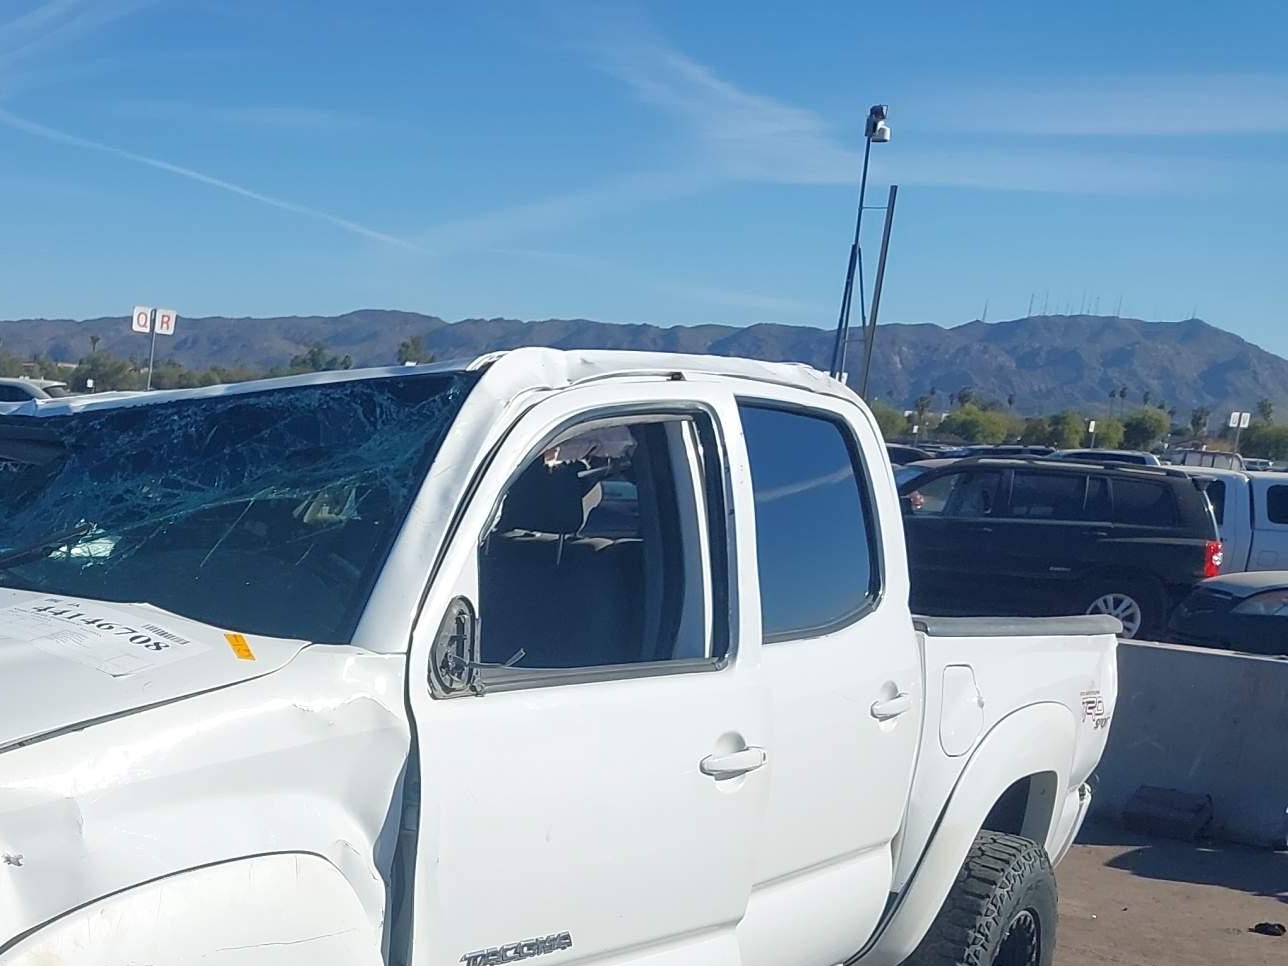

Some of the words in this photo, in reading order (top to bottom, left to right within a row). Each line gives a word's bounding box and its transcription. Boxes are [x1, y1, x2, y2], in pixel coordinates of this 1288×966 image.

[137, 311, 148, 328] Q
[160, 314, 170, 331] R
[32, 606, 170, 651] 44146708
